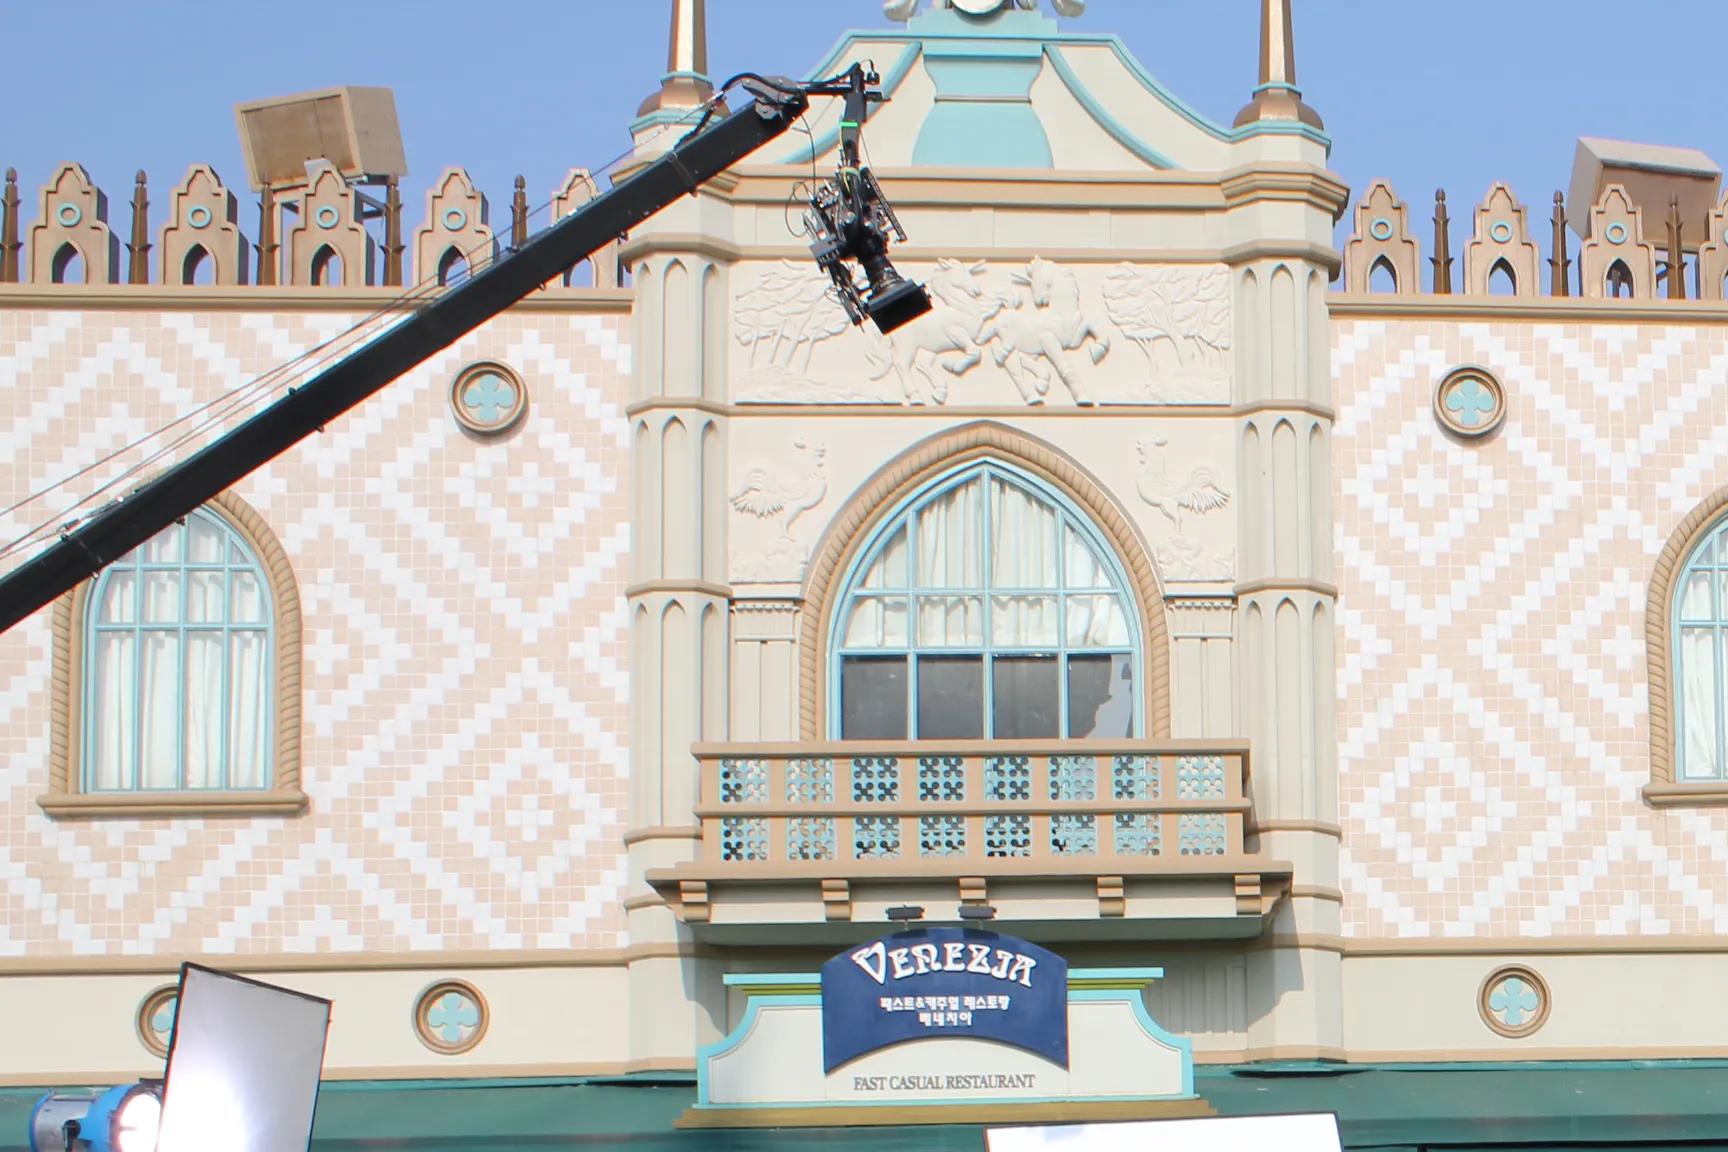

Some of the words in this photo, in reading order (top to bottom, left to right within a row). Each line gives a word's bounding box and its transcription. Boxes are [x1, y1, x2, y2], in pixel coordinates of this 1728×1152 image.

[963, 995, 1012, 1011] 레스토랑
[919, 1012, 973, 1026] 베네치아
[854, 1076, 887, 1091] FAST
[889, 1075, 943, 1090] CASUAL
[944, 1074, 1036, 1089] RESTAURANT
